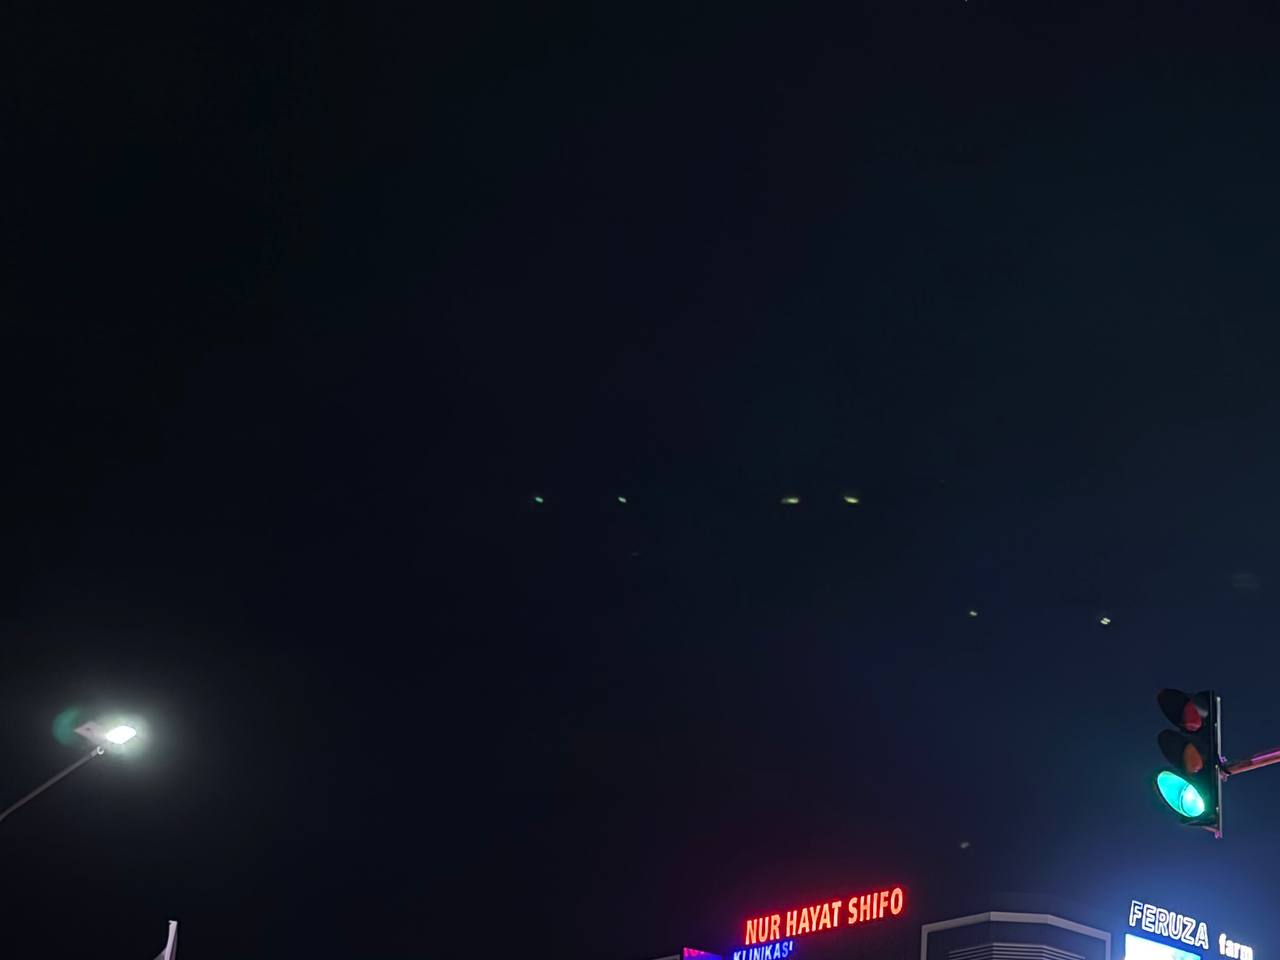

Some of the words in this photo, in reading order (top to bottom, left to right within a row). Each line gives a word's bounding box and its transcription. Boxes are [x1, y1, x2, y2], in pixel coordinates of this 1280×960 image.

[745, 914, 781, 945] NUR
[785, 901, 842, 937] HAYAT
[848, 887, 903, 925] SHIFO
[1129, 900, 1209, 950] FERUZA
